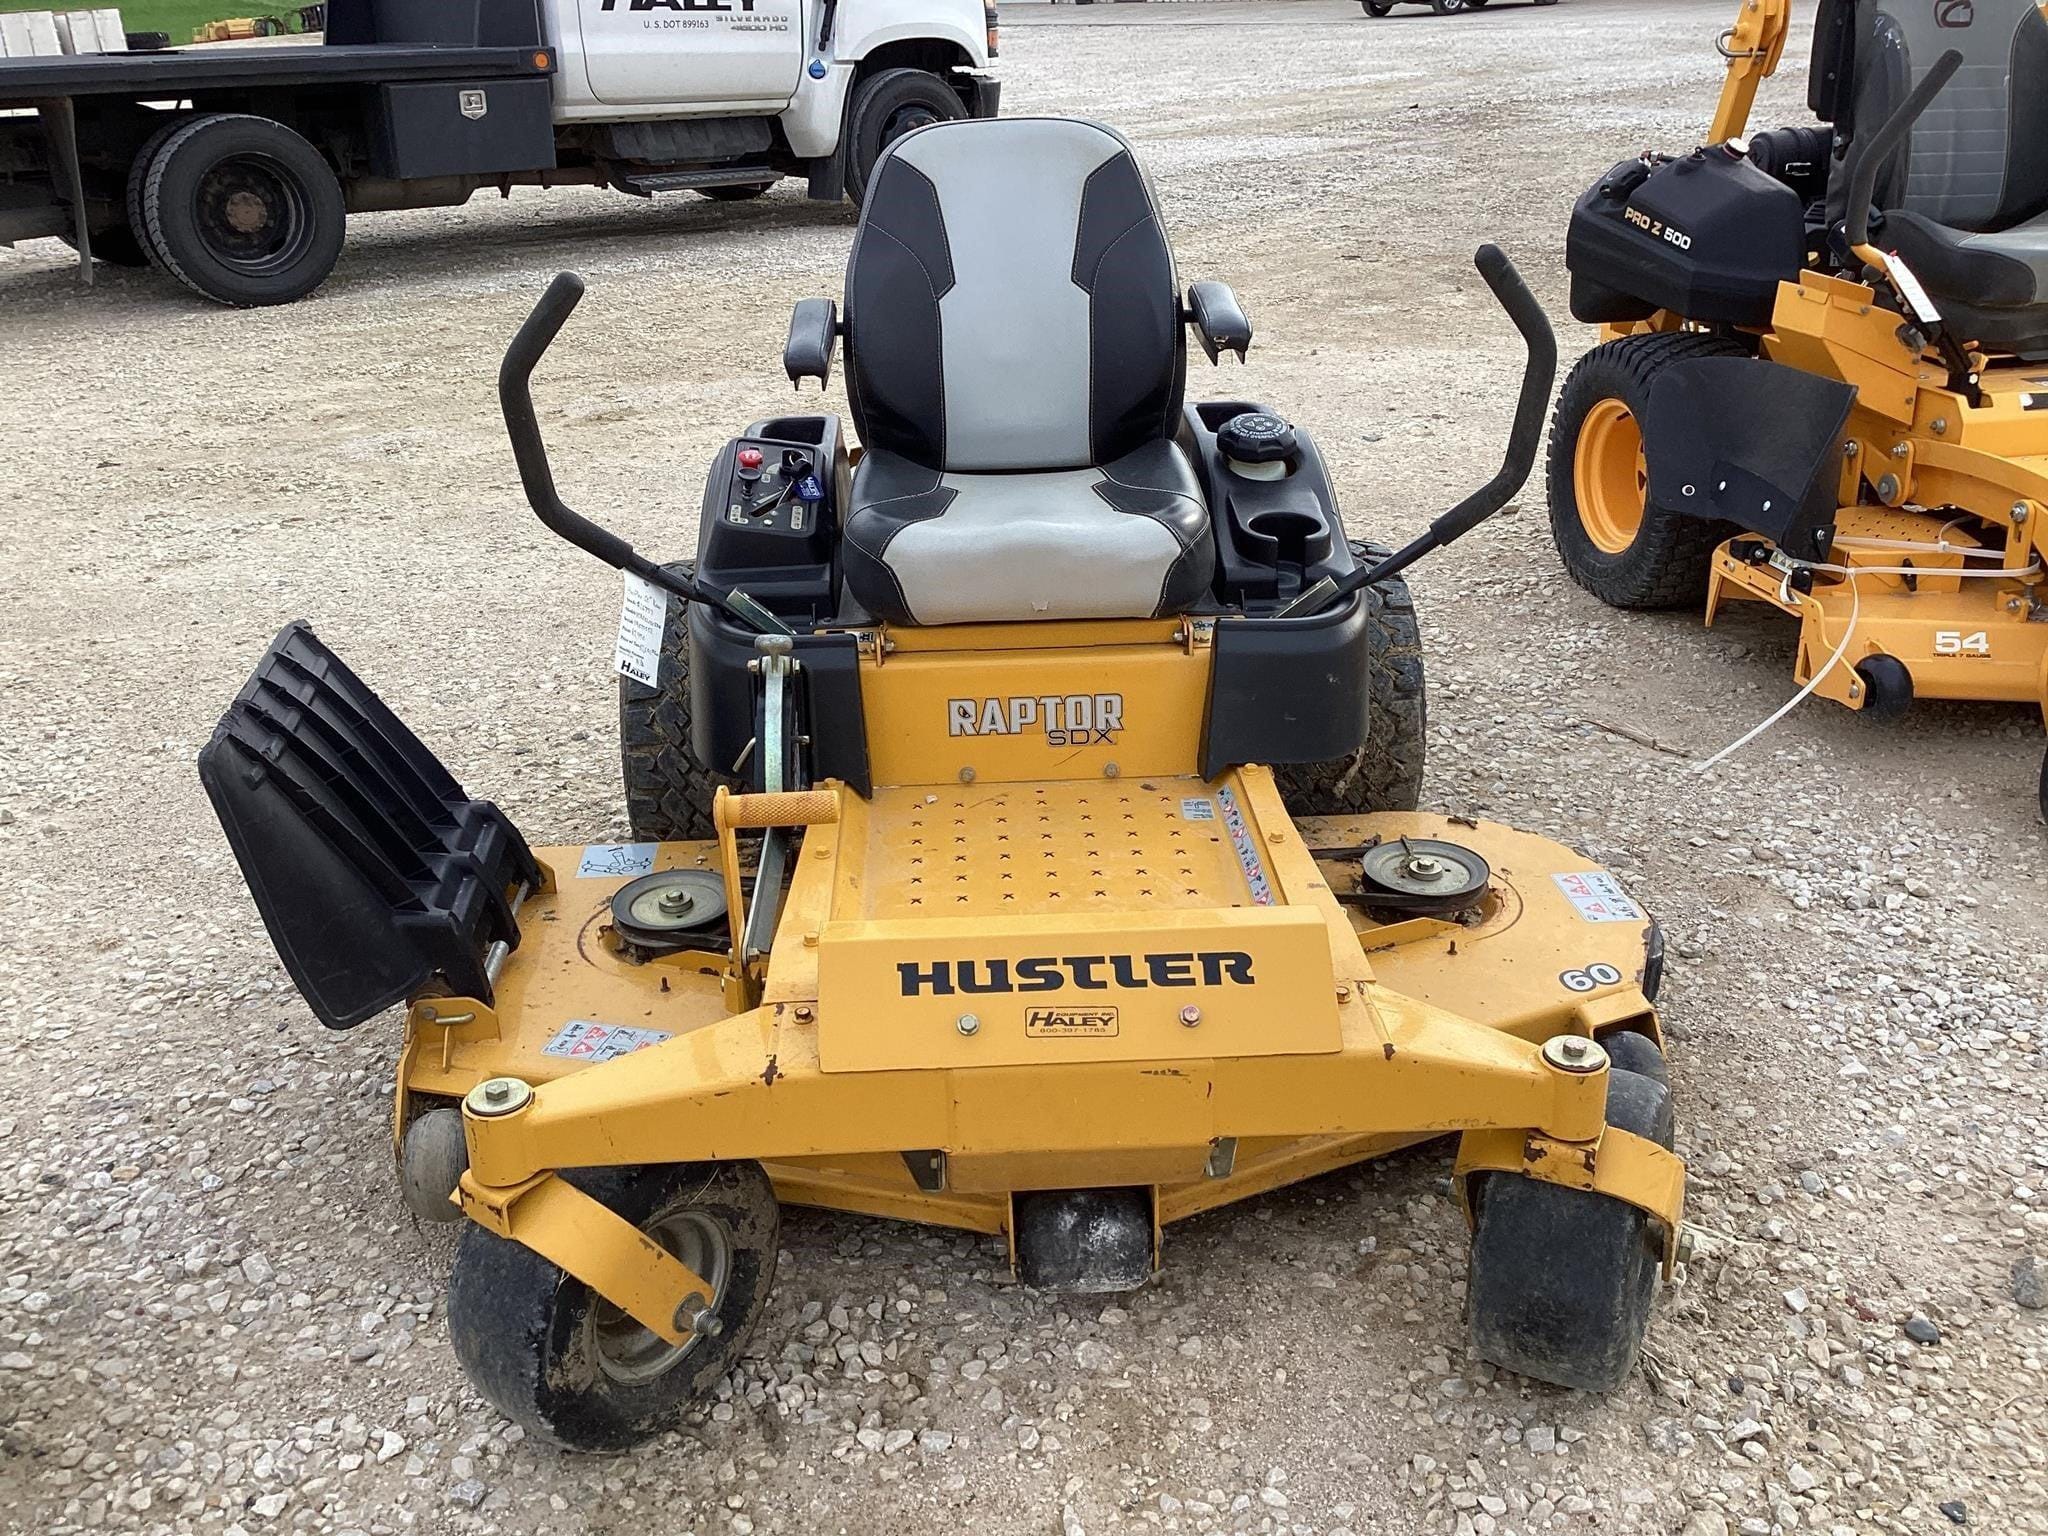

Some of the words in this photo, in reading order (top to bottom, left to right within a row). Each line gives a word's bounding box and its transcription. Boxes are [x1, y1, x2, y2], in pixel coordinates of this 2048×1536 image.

[663, 20, 681, 29] DOT
[682, 19, 709, 29] 899163
[716, 15, 788, 23] SILVERADO
[1624, 206, 1651, 230] PRO
[1651, 221, 1663, 236] Z
[1663, 226, 1692, 250] 500
[1935, 631, 1990, 653] 54
[620, 660, 651, 681] HALEY
[948, 693, 1125, 737] RAPTOR
[1048, 728, 1114, 746] SDX
[897, 951, 1255, 997] HUSTLER
[1559, 962, 1622, 992] 60
[1029, 1012, 1115, 1027] HALEY
